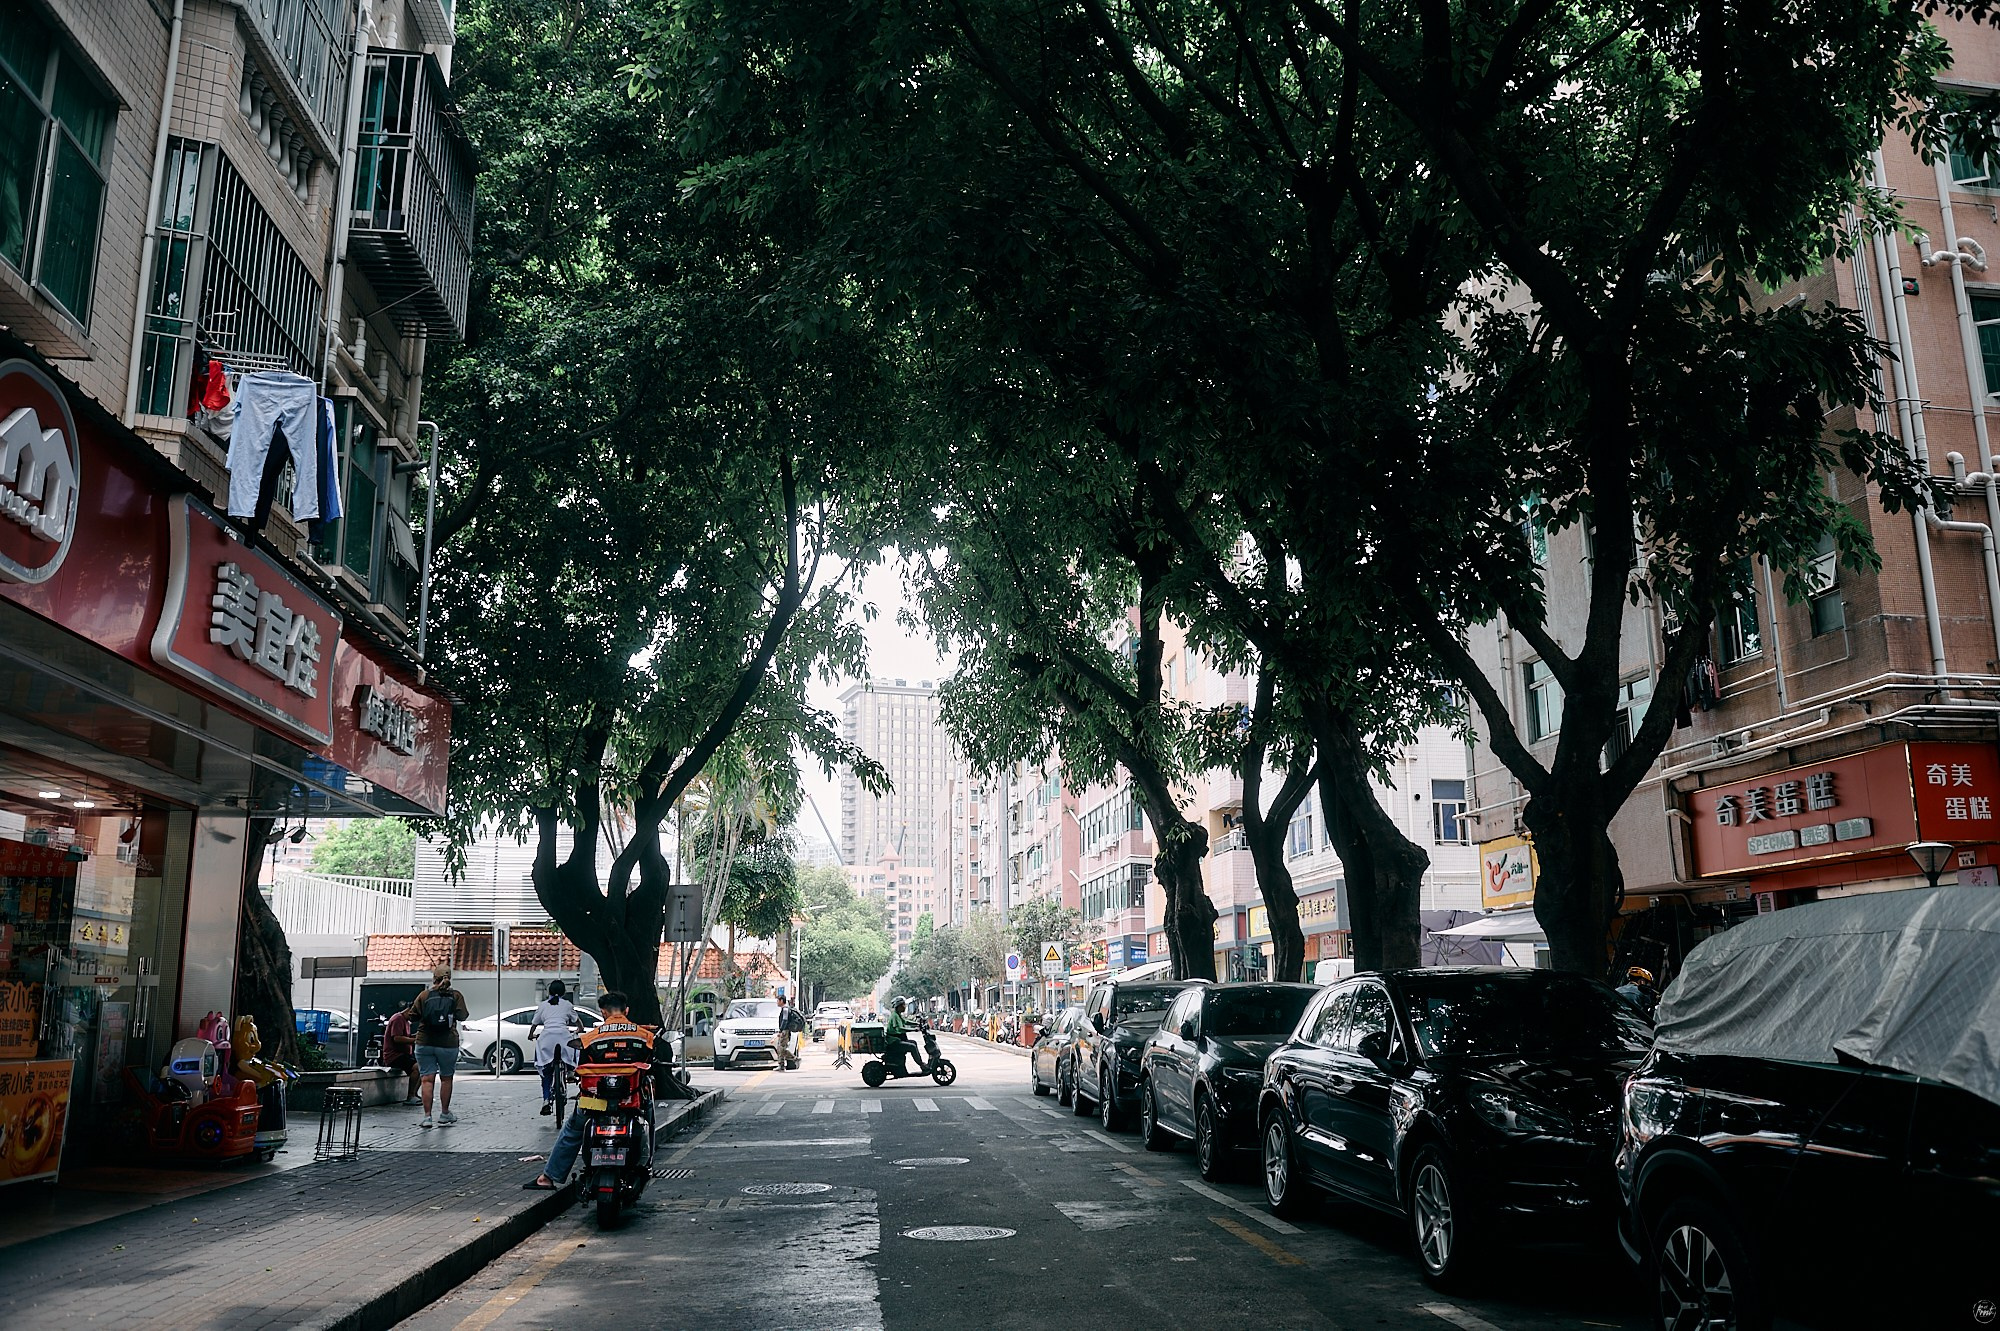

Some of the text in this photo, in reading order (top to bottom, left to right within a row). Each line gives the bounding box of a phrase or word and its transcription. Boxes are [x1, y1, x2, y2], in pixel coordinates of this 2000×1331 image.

[210, 562, 321, 698] 美宜佳
[359, 685, 417, 756] 便利店
[1926, 763, 1974, 787] 奇美
[1714, 772, 1837, 827] 奇美蛋糕
[1945, 796, 1992, 820] 蛋糕
[1749, 833, 1793, 852] SPECIAL
[594, 1153, 624, 1161] 小牛电动
